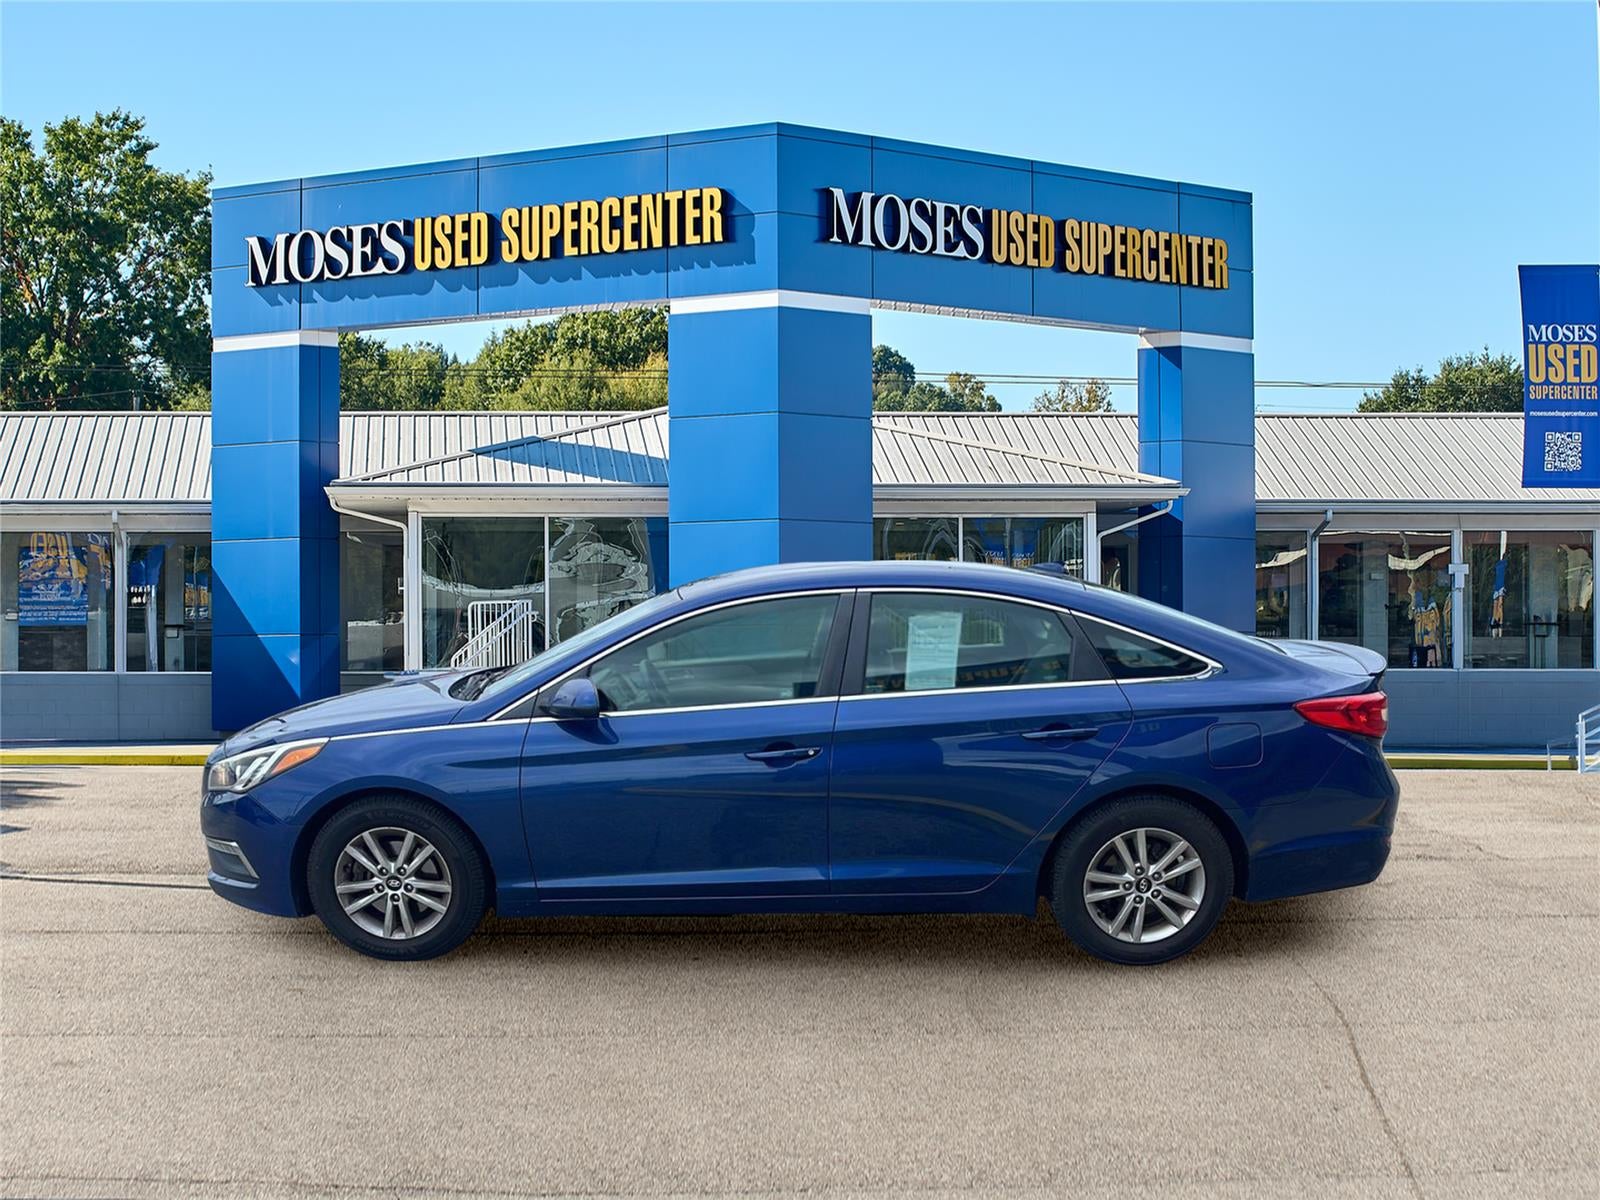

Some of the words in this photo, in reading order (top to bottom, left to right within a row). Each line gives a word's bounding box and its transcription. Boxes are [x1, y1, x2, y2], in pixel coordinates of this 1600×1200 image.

[244, 220, 407, 288] MOSES
[413, 211, 490, 272] USED
[500, 187, 725, 264] SUPERCENTER
[828, 187, 985, 261] MOSES
[991, 208, 1056, 269] USED
[1064, 218, 1230, 290] SUPERCENTER
[1527, 323, 1597, 342] MOSES
[1528, 344, 1598, 384] USED
[1529, 385, 1598, 400] SUPERCENTER
